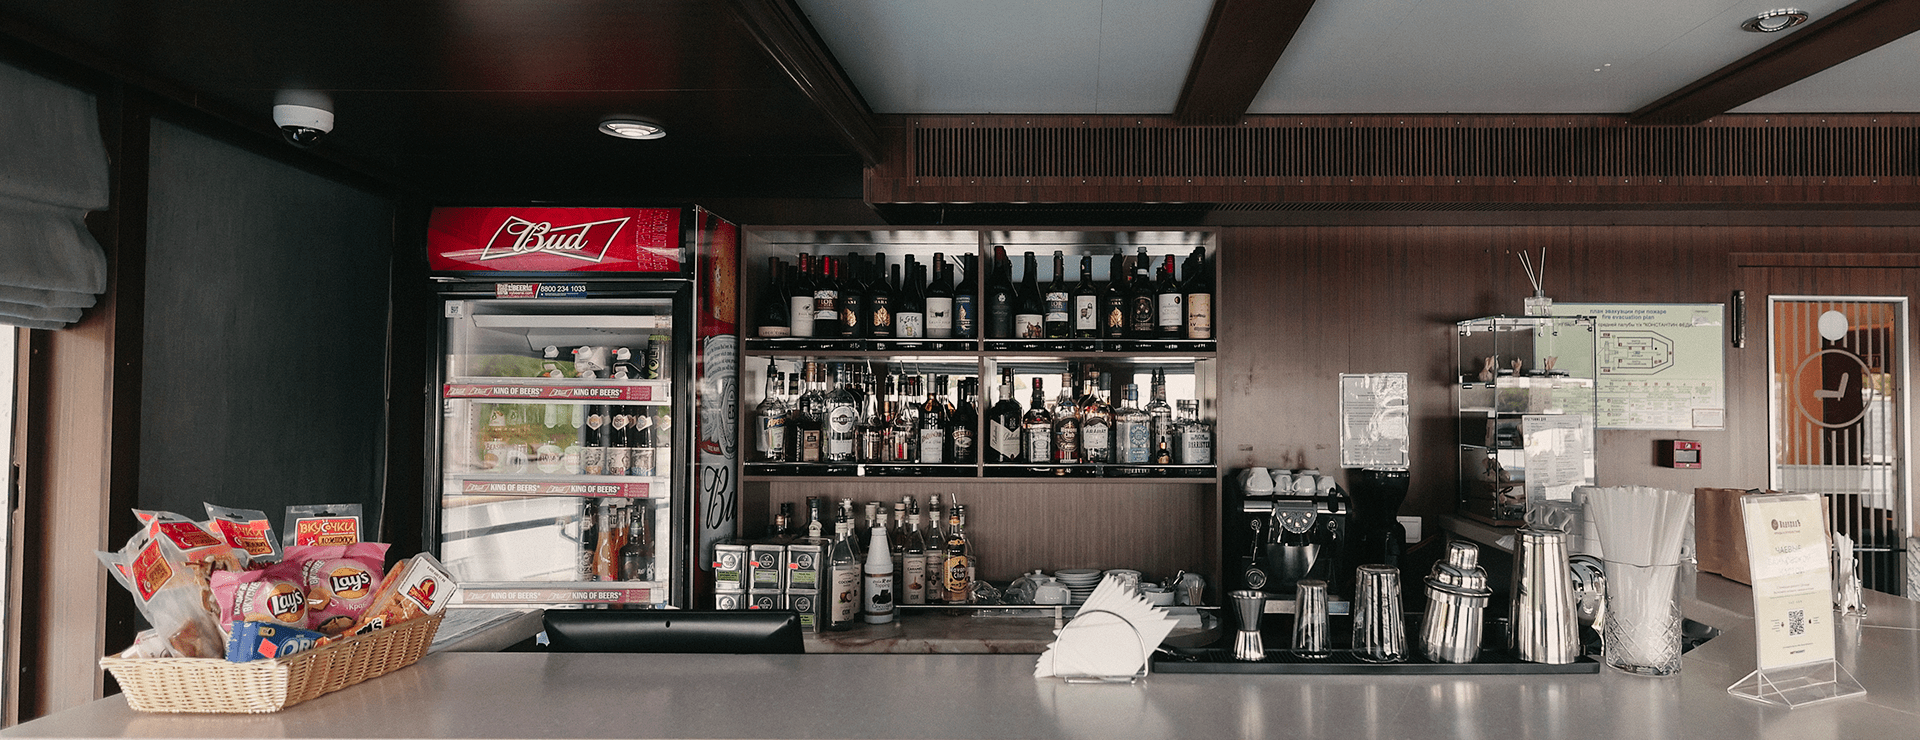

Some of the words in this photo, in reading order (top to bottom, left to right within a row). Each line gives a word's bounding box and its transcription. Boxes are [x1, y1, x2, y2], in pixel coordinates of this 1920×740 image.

[507, 221, 588, 252] Bud
[510, 387, 518, 395] OF
[573, 388, 590, 396] KING
[590, 388, 598, 396] OF
[571, 485, 587, 493] KING
[587, 485, 596, 493] OF
[704, 465, 735, 529] Bu
[299, 519, 355, 534] ВКУСОЧКИ
[332, 572, 371, 592] Lay's
[271, 590, 302, 616] Lay's
[589, 592, 597, 600] OF
